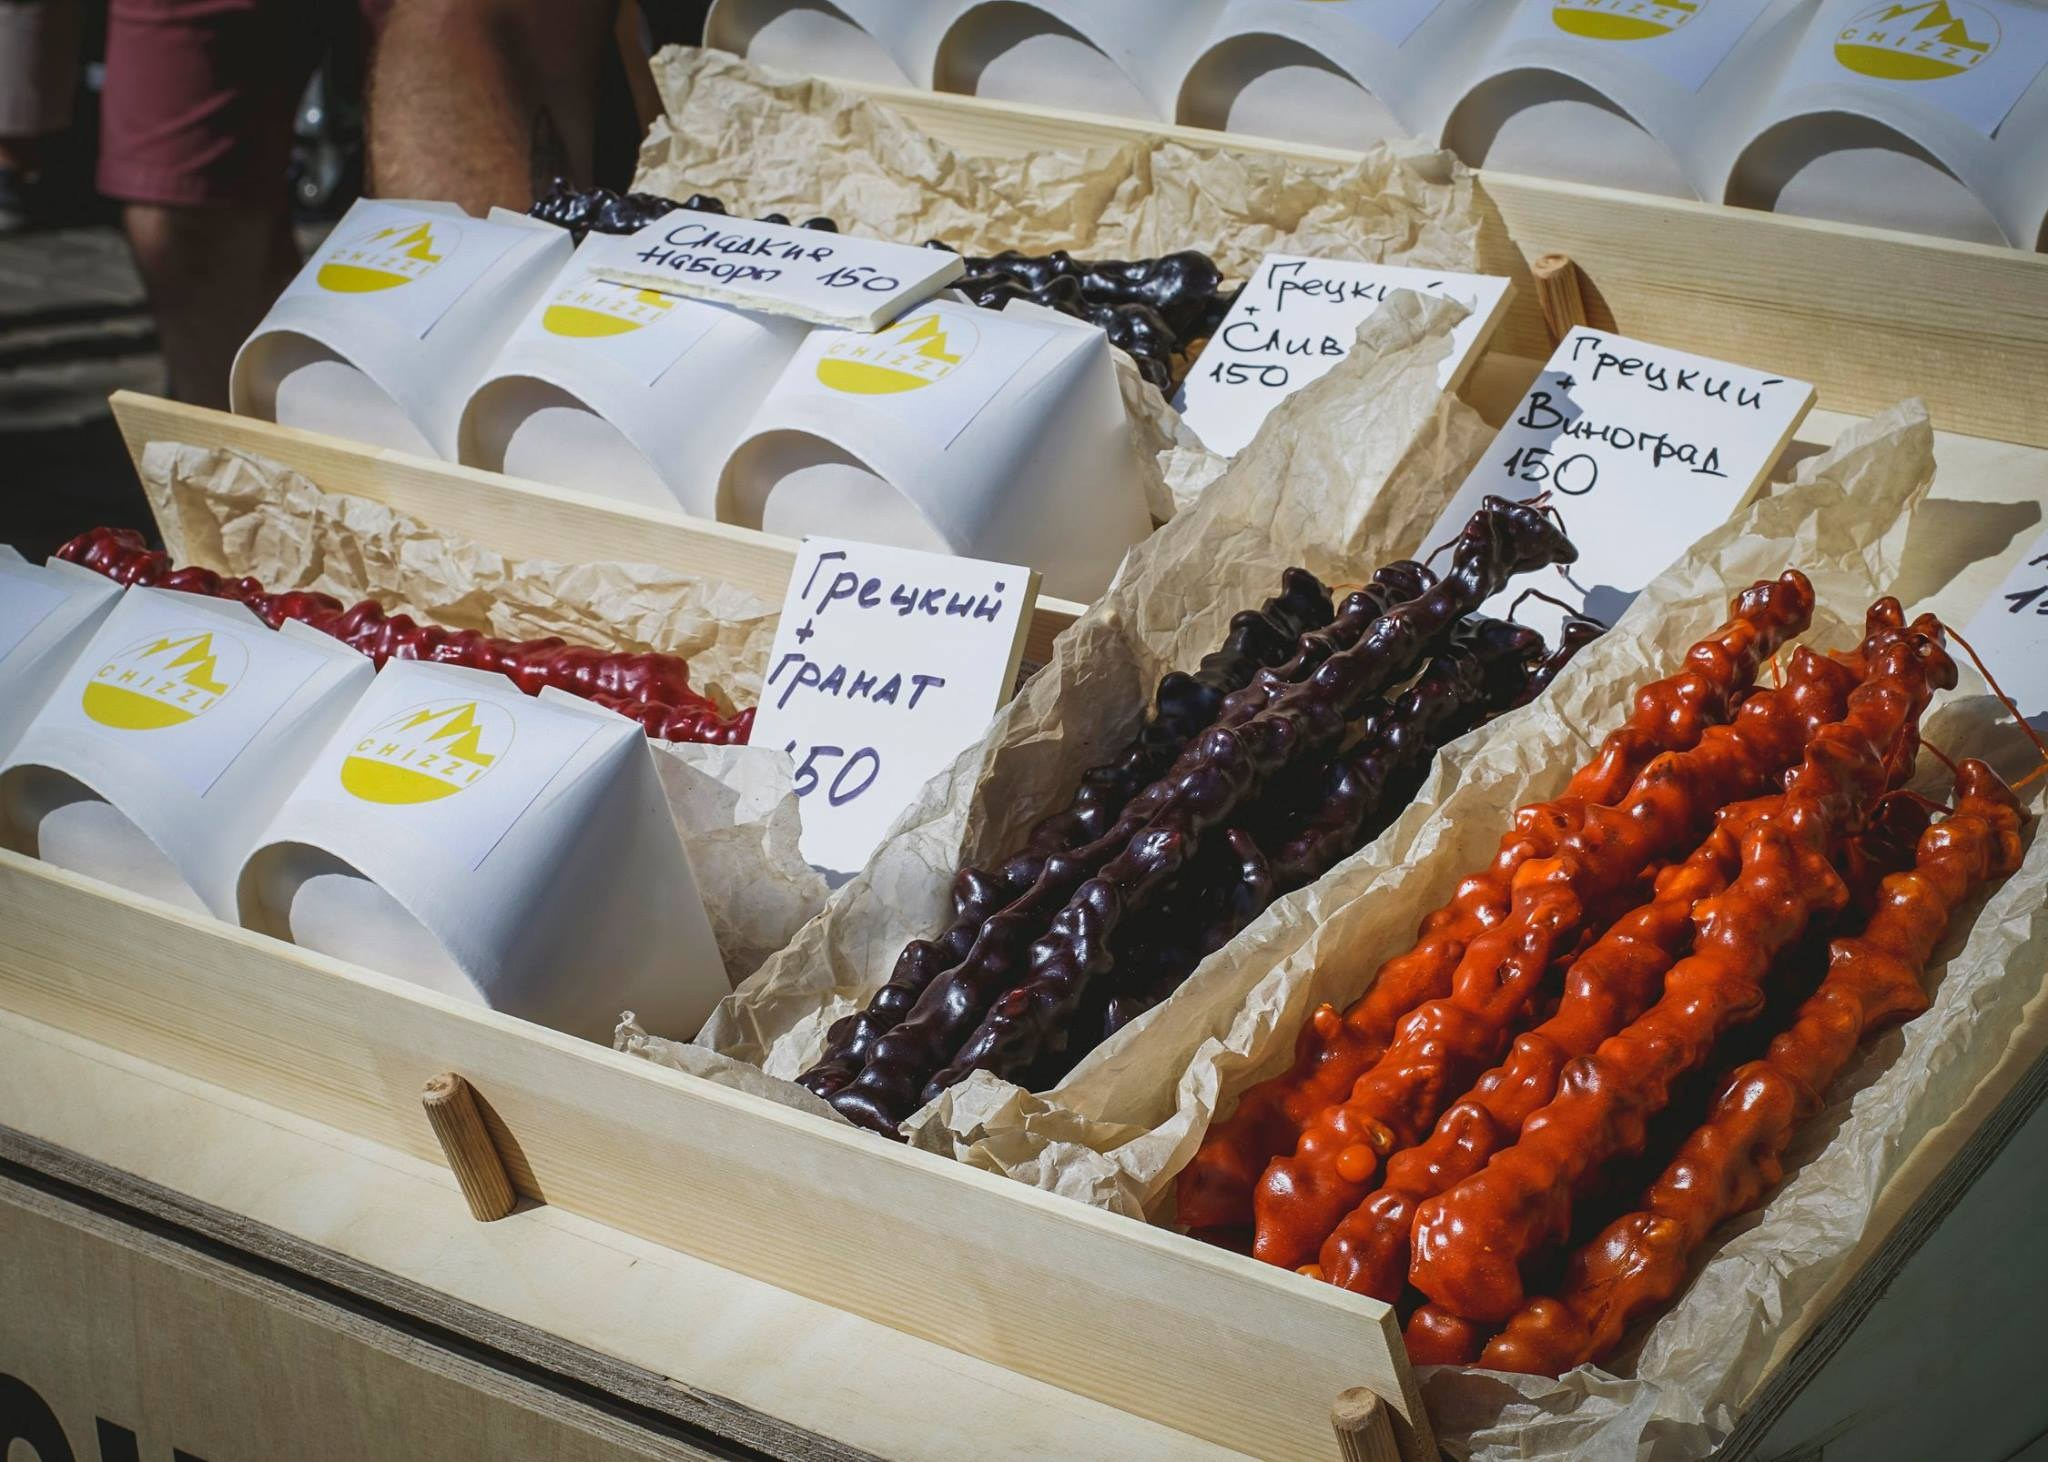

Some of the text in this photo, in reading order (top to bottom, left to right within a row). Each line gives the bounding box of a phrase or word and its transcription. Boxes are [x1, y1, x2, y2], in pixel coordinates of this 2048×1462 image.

[1839, 28, 1982, 65] CHIZZI
[330, 248, 432, 276] CHIZZI
[664, 223, 835, 262] Сладкие
[816, 266, 900, 292] 150
[1267, 260, 1444, 313] Грецк
[556, 289, 664, 323] CHIZZI
[827, 343, 952, 379] CHIZZI
[1209, 362, 1290, 388] 150
[1572, 336, 1785, 410] Грецкий
[1516, 391, 1729, 478] Виноград
[1503, 447, 1599, 496] 150
[800, 550, 1007, 623] Грецкий
[96, 662, 217, 712] CHIZZI
[354, 737, 482, 784] CHIZZI
